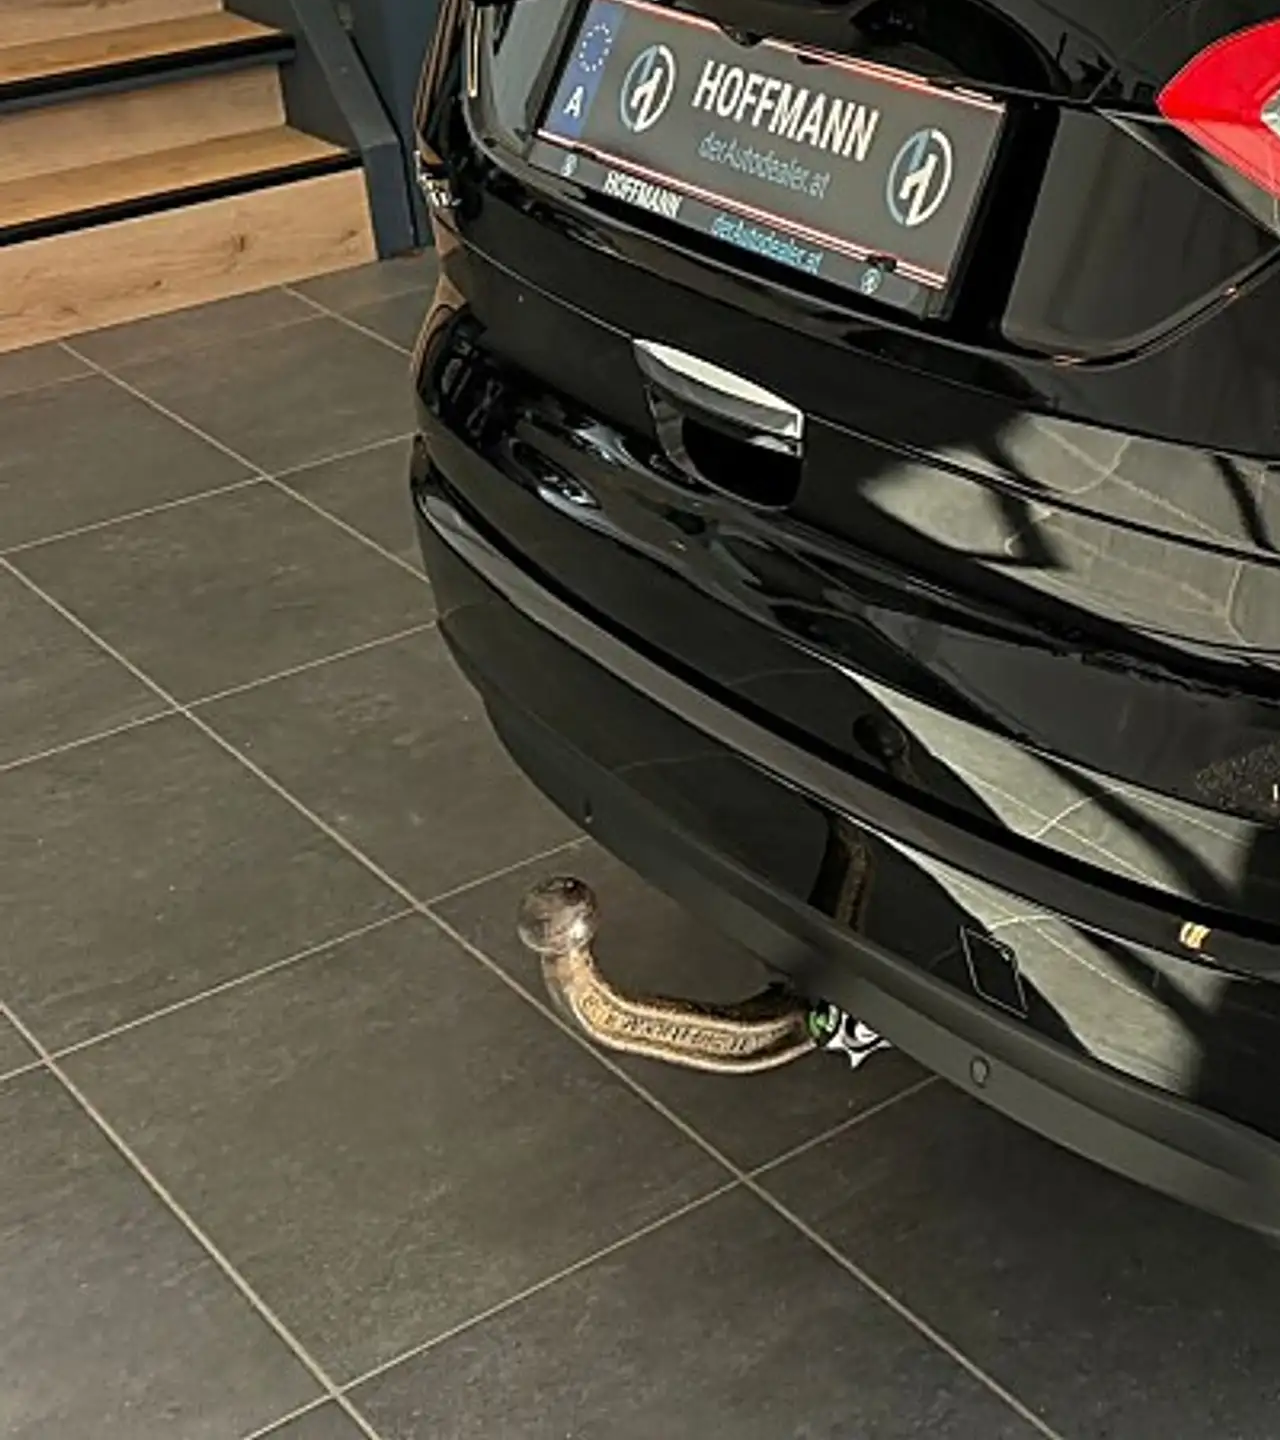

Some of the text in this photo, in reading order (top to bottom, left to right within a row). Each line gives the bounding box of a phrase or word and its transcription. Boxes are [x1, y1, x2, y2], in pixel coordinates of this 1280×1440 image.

[562, 85, 584, 120] A
[691, 59, 880, 162] HOFFMANN
[602, 169, 684, 219] HOFFMANN
[698, 131, 832, 199] derAutodealer.at
